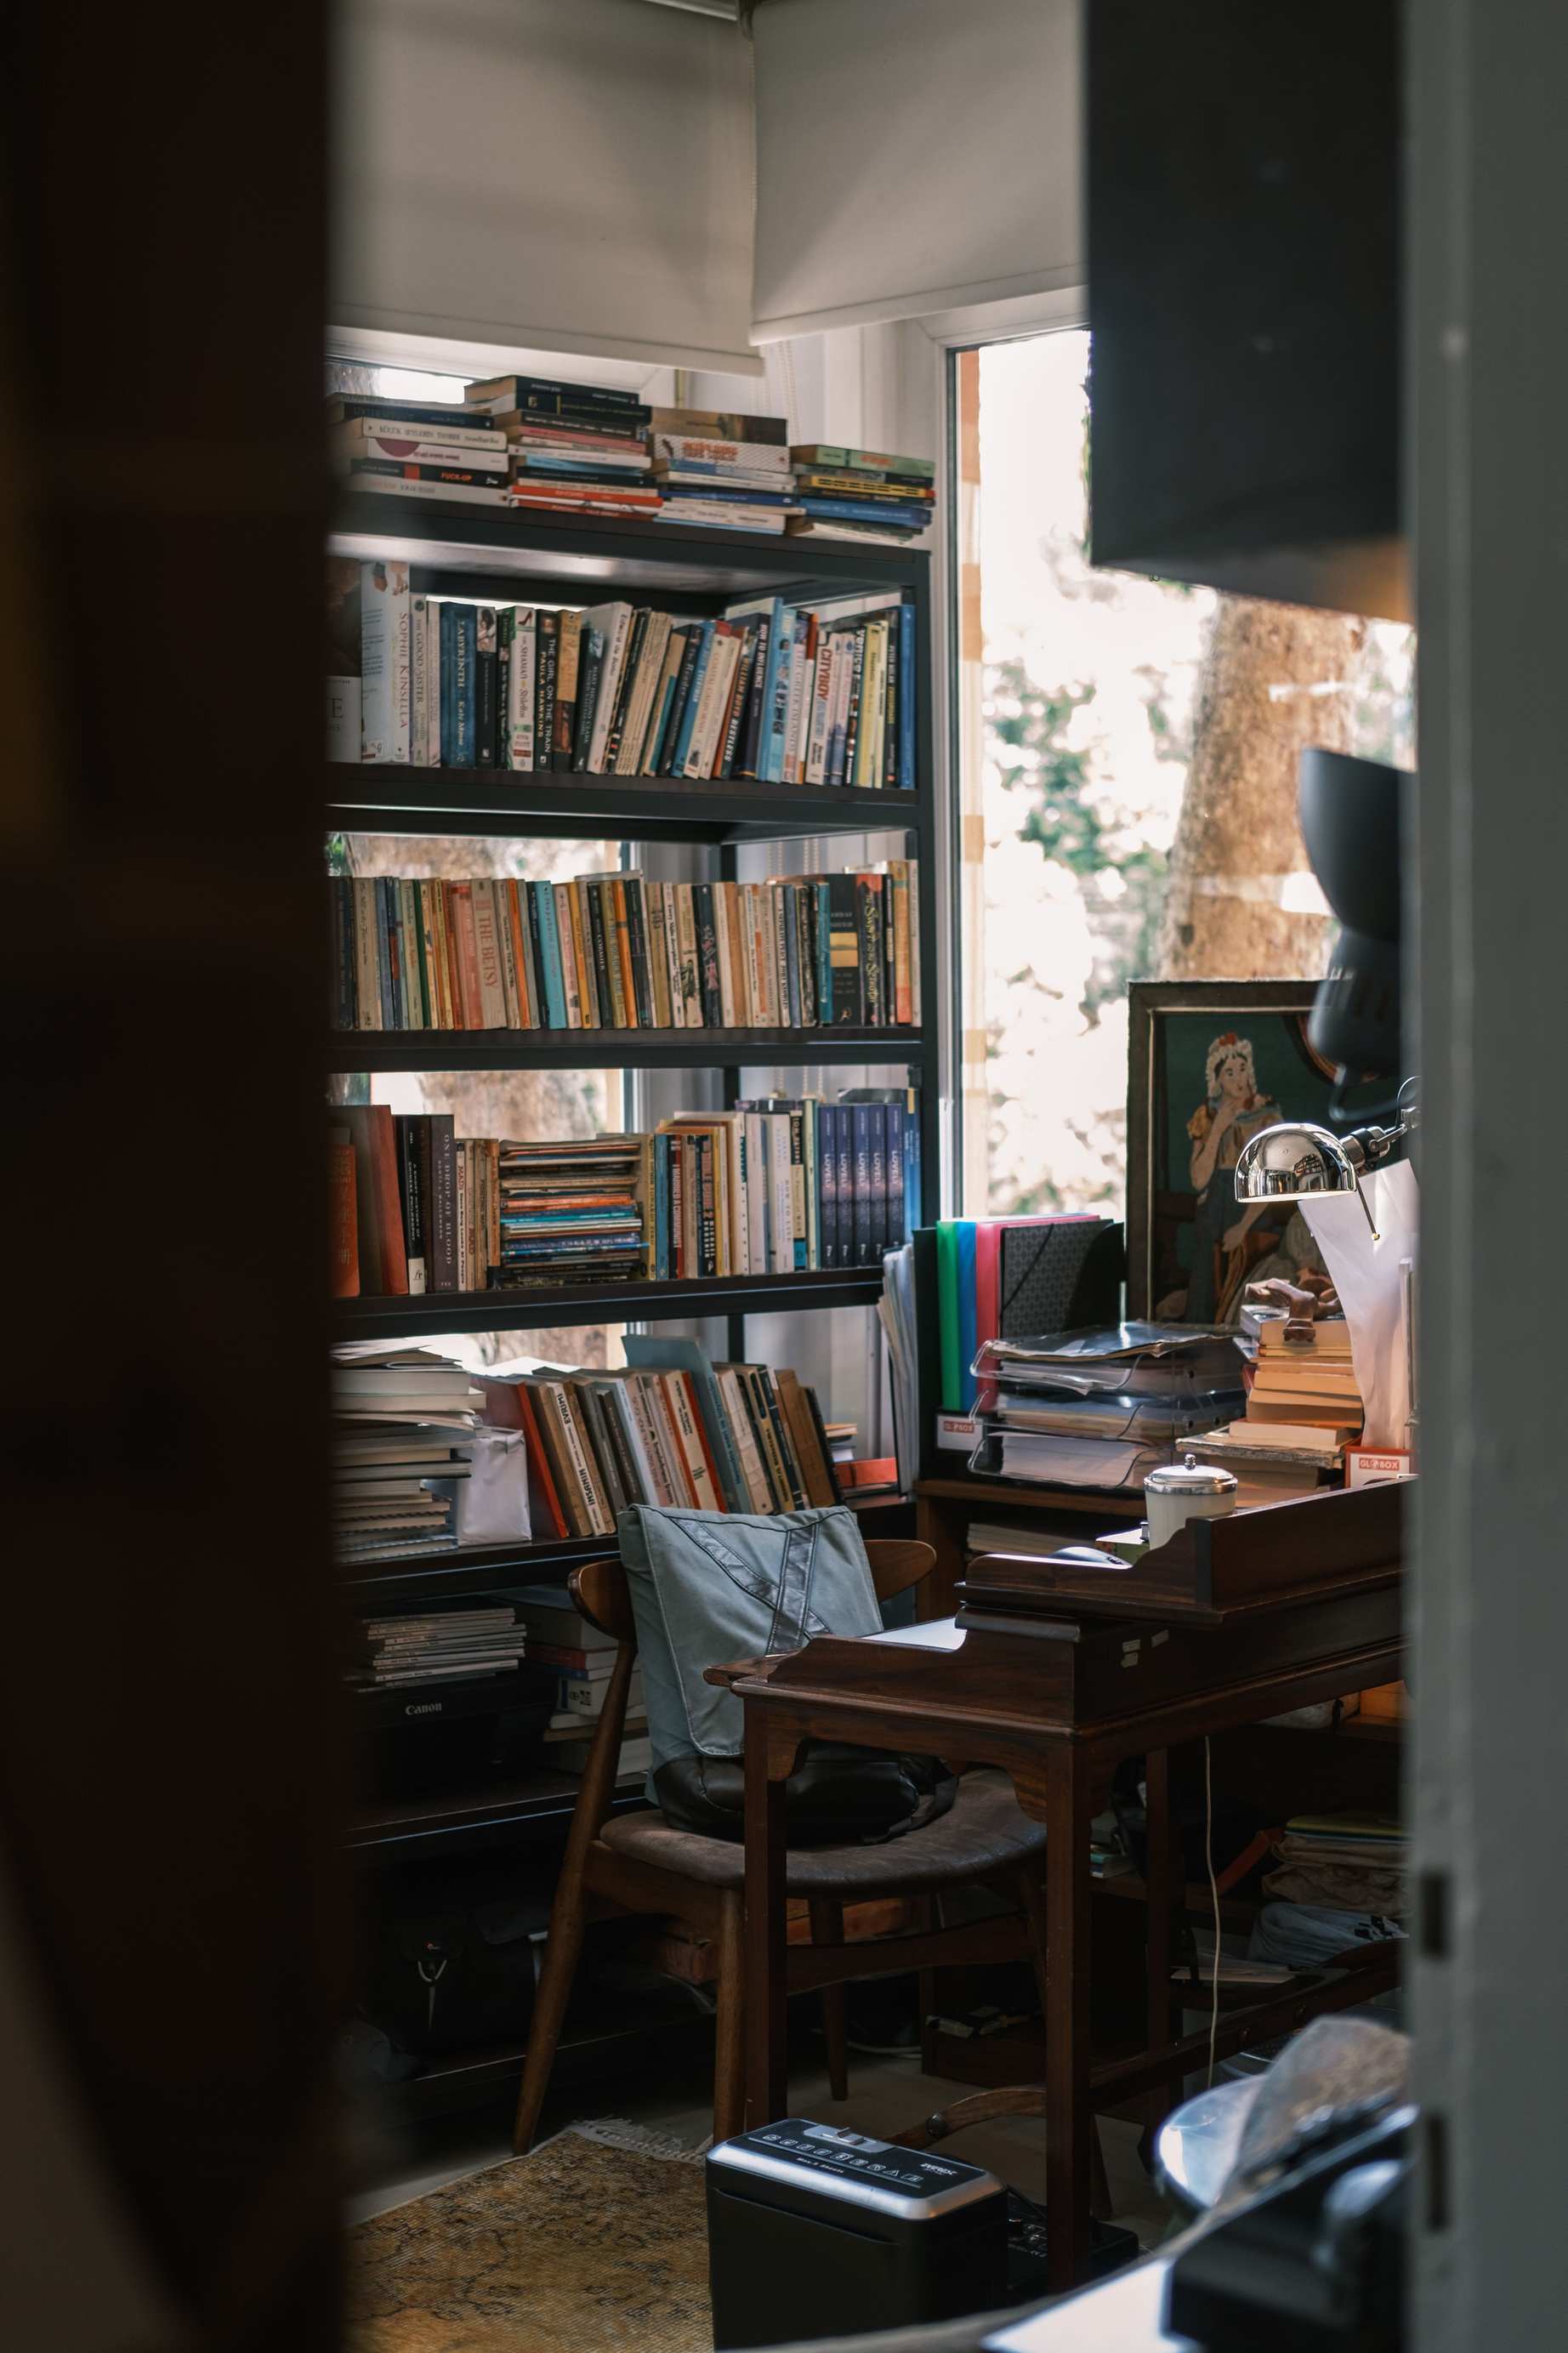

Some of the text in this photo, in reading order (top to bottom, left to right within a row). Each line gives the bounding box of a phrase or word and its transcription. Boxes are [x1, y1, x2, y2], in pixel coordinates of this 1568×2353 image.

[754, 624, 768, 689] HOW TO INFLUENCE
[817, 648, 833, 701] CITYBOY
[399, 666, 408, 728] KINSELLA
[546, 685, 554, 699] ON
[734, 695, 743, 717] BOYD
[724, 718, 739, 762] RESTLESS
[478, 916, 498, 989] THE BETSY
[673, 1168, 681, 1199] MARRIED
[873, 1152, 882, 1186] LOVELY
[446, 1202, 452, 1219] OF
[673, 1206, 682, 1248] COMMUNIST
[405, 1702, 442, 1715] Canon
